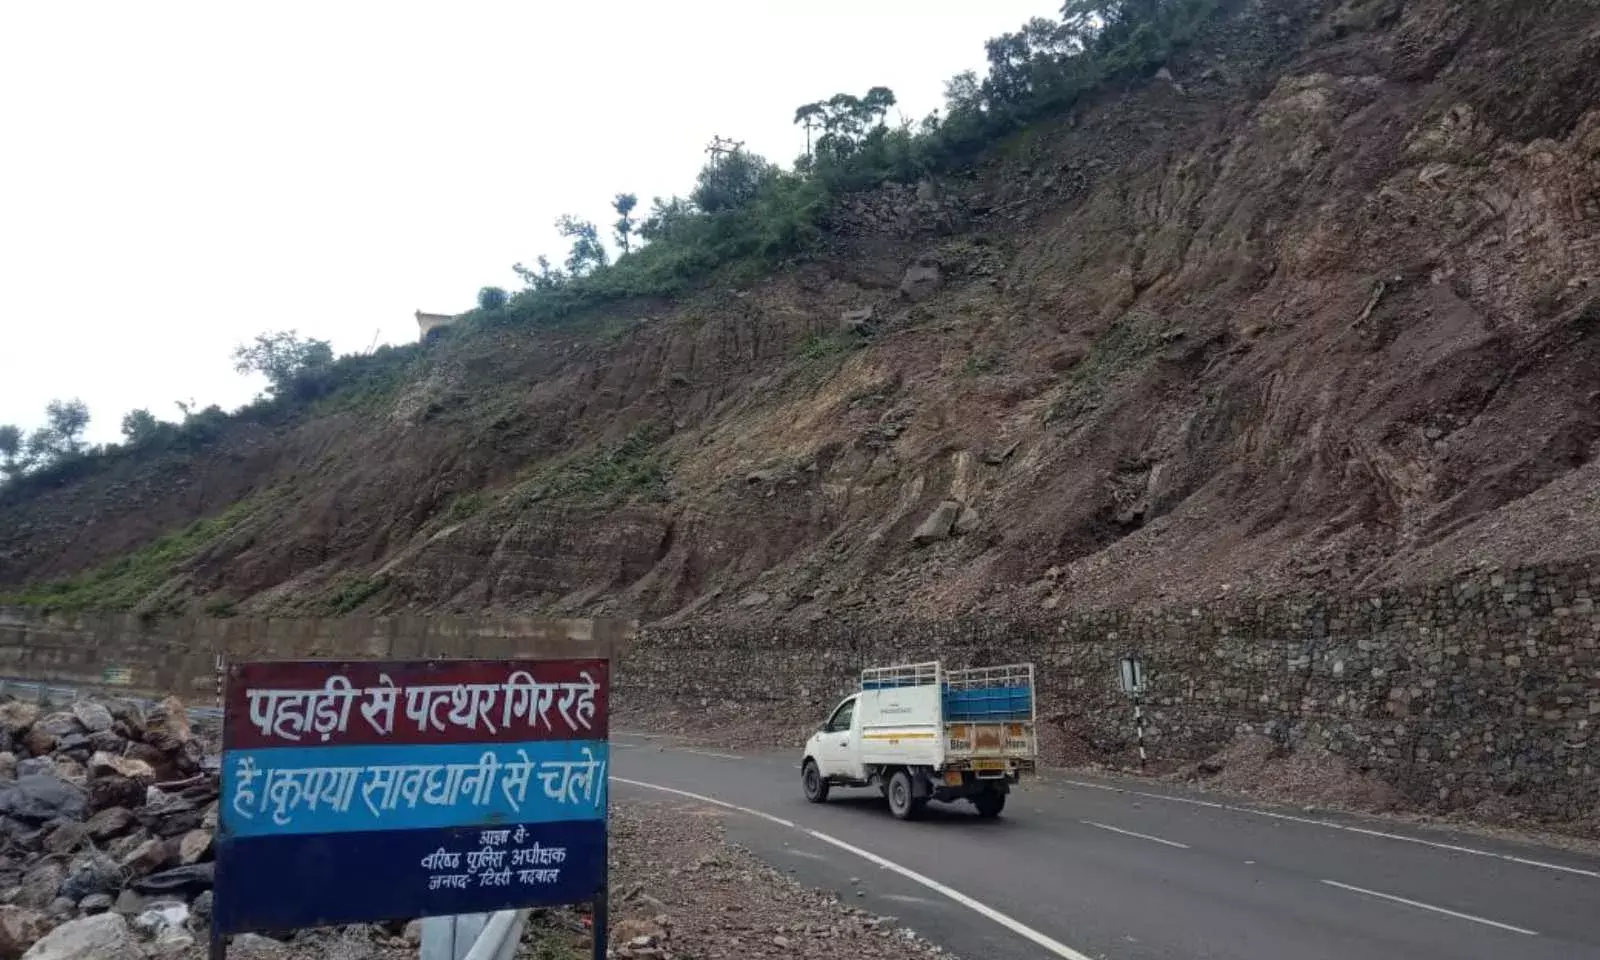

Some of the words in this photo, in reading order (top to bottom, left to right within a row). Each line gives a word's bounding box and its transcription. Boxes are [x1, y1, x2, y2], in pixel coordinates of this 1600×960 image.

[246, 675, 362, 742] पहाड़ी
[361, 672, 402, 736] से
[405, 683, 500, 735] पत्थर
[501, 670, 560, 732] गिर
[557, 671, 601, 732] रहे
[361, 751, 502, 819] सावधानी
[501, 748, 536, 813] से
[467, 846, 507, 874] पुलिस
[511, 841, 567, 866] अधीक्षक
[478, 866, 514, 888] टिहरी
